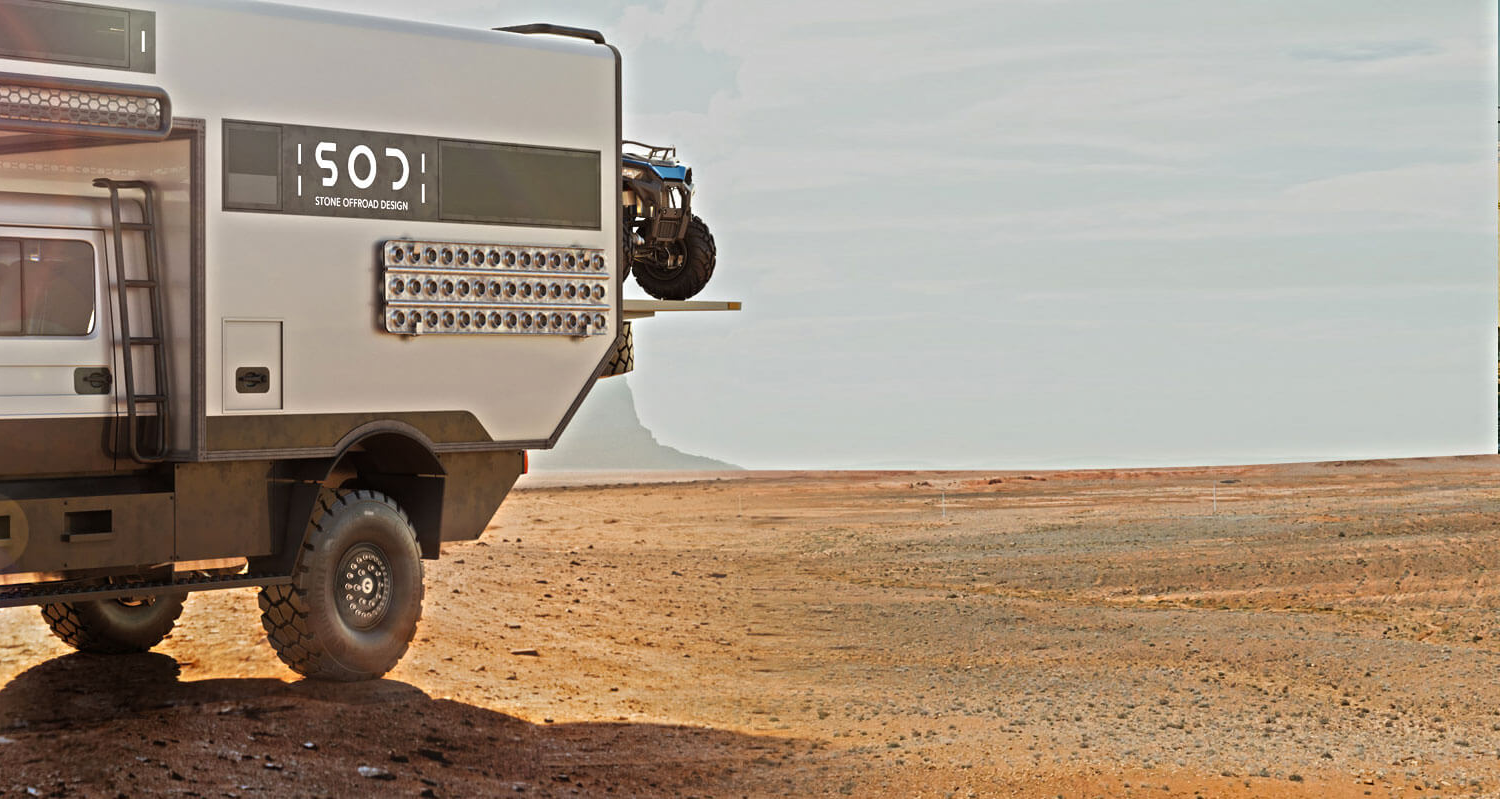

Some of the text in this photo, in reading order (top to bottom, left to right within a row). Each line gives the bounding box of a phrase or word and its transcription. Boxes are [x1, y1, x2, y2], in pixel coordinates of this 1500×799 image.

[315, 196, 409, 211] STONE OFFROAD DESIGN
